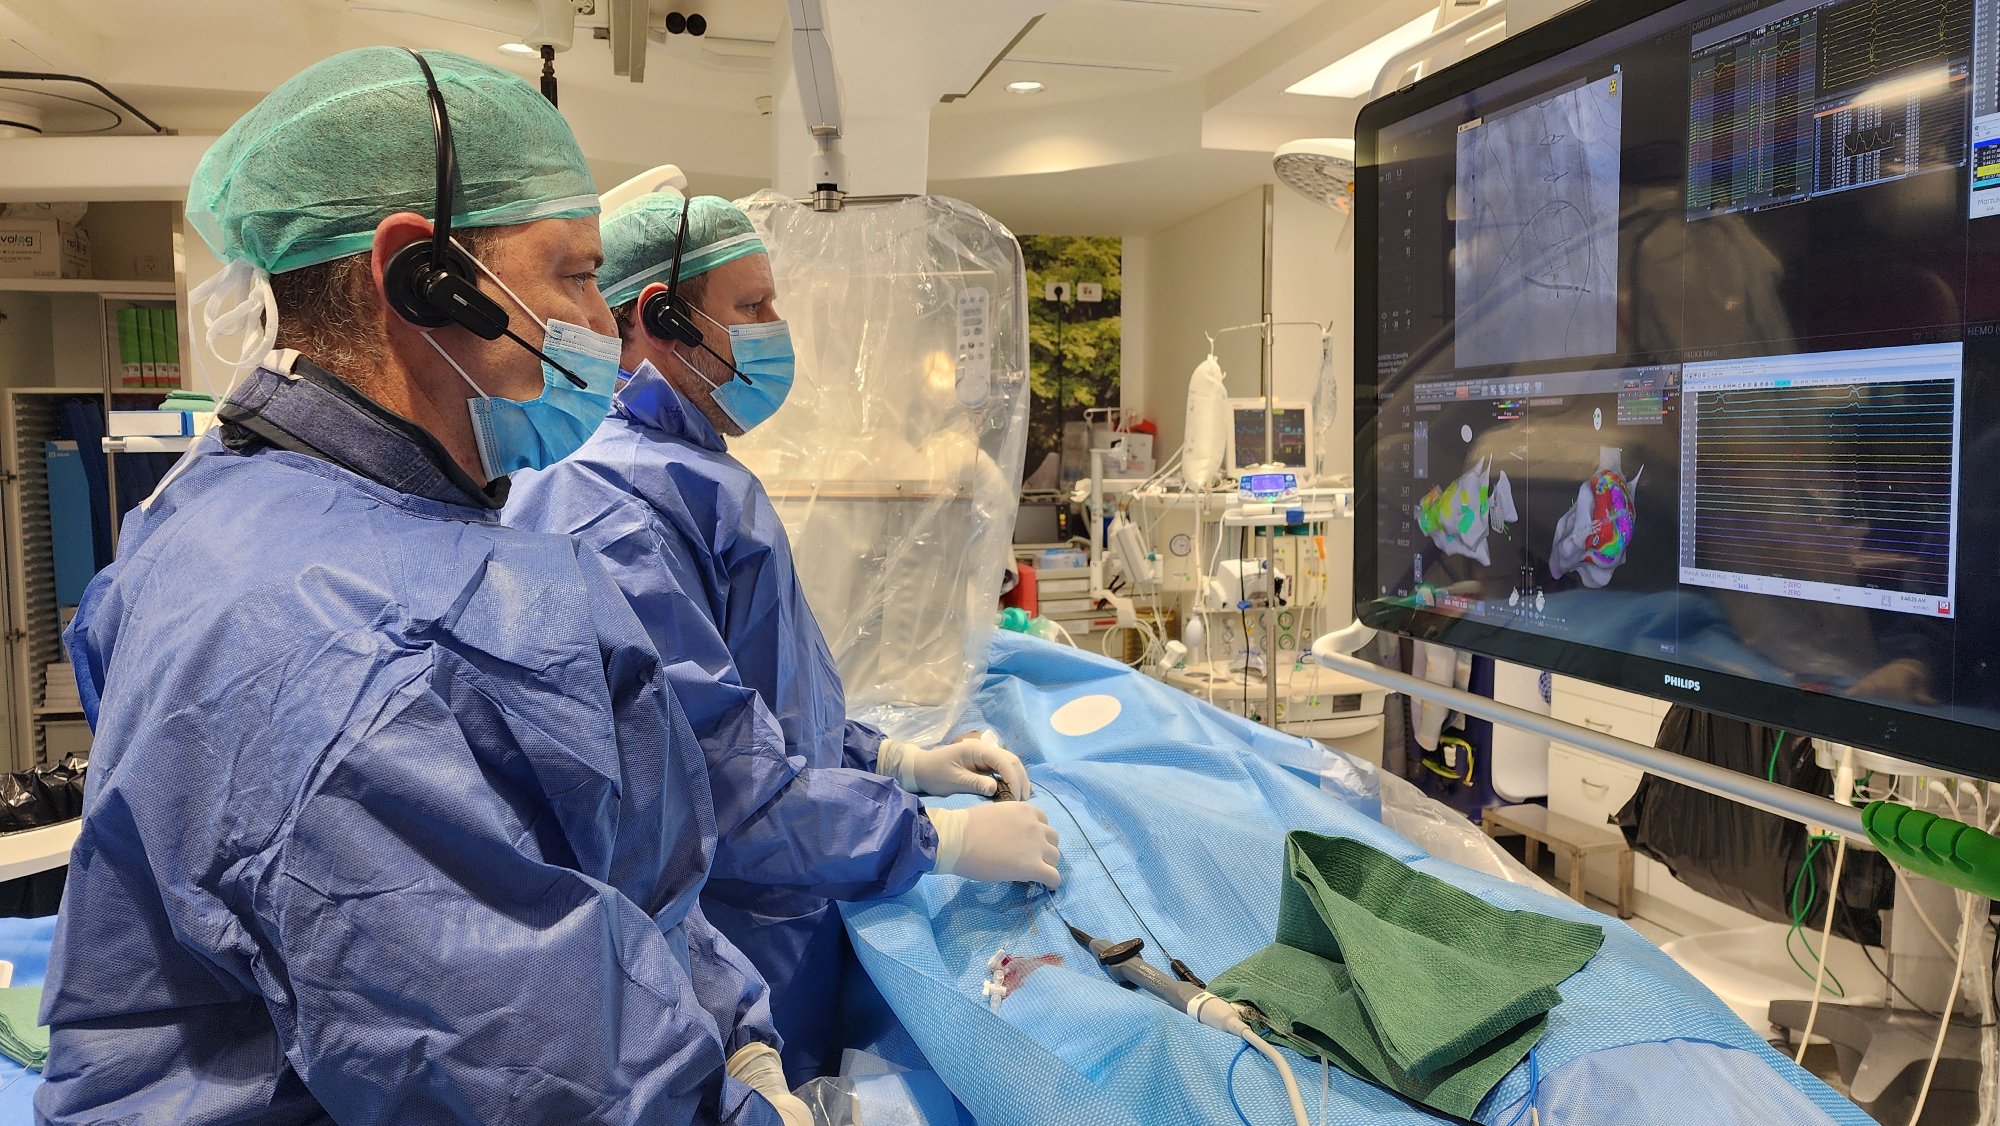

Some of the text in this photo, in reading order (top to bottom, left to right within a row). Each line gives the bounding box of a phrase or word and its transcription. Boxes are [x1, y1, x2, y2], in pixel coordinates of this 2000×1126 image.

[1711, 13, 1726, 24] Main
[1967, 325, 1994, 336] HEMO
[1414, 427, 1428, 440] N/A
[1787, 581, 1802, 589] ZERO
[1787, 589, 1802, 597] ZERO
[1664, 674, 1701, 692] PHILIPS
